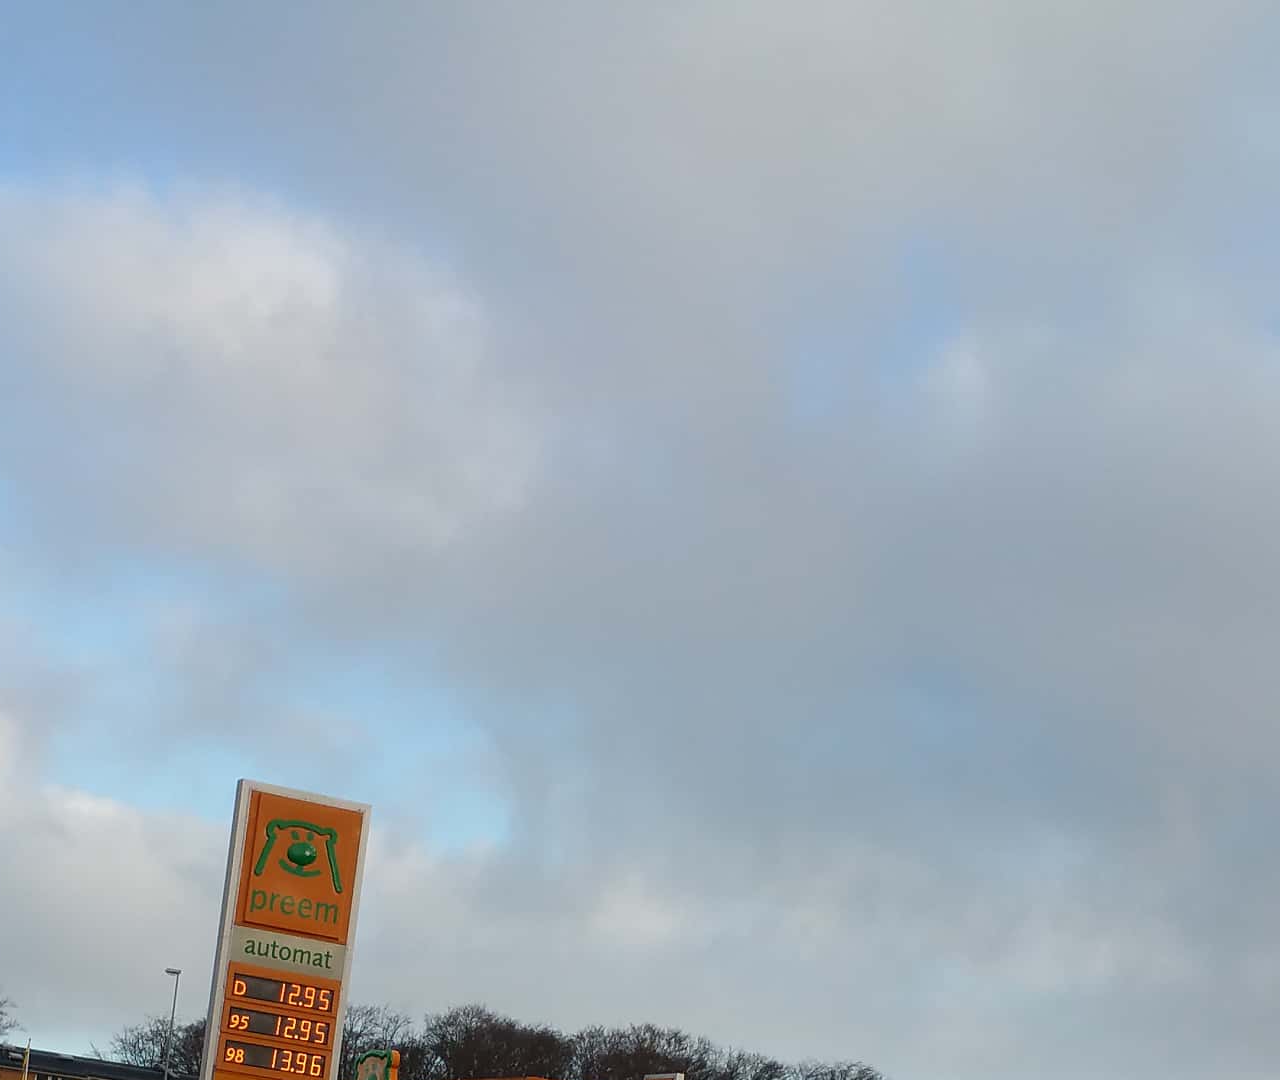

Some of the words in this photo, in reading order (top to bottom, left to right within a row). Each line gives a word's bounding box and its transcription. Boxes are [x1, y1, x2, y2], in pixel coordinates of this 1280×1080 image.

[248, 890, 338, 924] preem
[244, 940, 332, 969] automat
[233, 982, 246, 996] D
[280, 984, 330, 1011] 12.95
[230, 1015, 250, 1030] 95
[275, 1016, 326, 1044] 12.95
[225, 1048, 245, 1064] 98
[271, 1049, 322, 1077] 13.96
